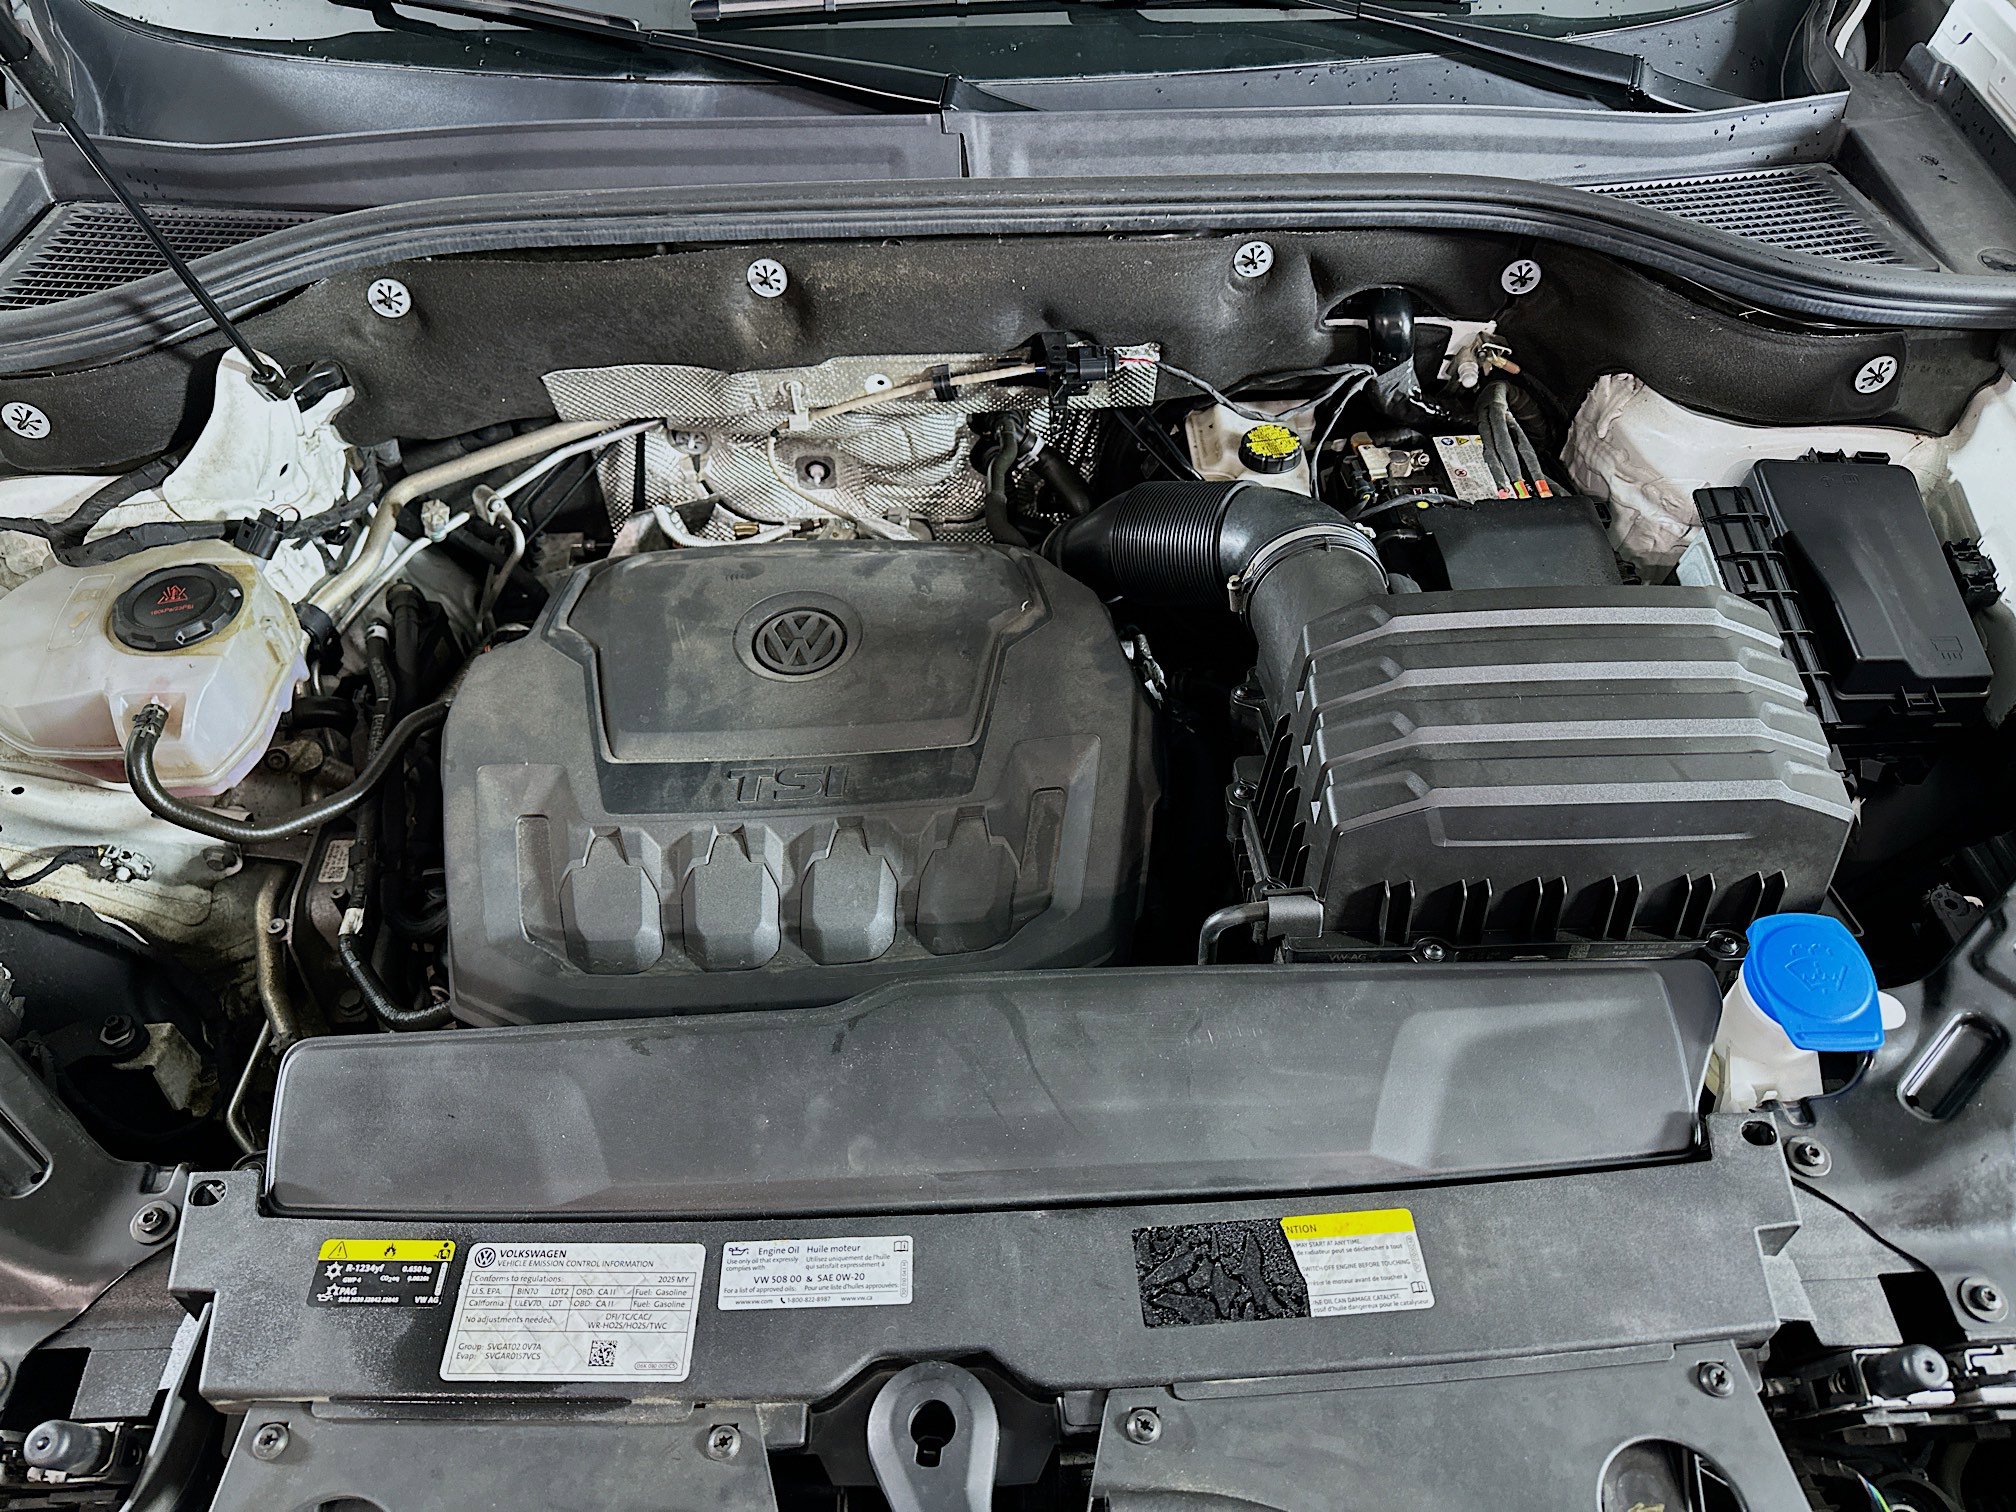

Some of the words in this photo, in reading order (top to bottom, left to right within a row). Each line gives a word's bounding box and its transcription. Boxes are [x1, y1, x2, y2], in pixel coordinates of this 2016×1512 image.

[727, 764, 849, 804] TSI
[1285, 1224, 1317, 1234] NTION
[758, 1247, 786, 1257] Engine
[787, 1246, 800, 1254] Oil
[807, 1245, 829, 1253] Huile
[830, 1244, 861, 1253] moteur
[500, 1249, 567, 1259] VOLKSWAGEN
[602, 1260, 654, 1268] INFORMATION
[738, 1258, 751, 1266] only
[772, 1256, 799, 1264] expressly
[1336, 1262, 1357, 1270] ENGINE
[1380, 1259, 1411, 1267] TOUCHING
[345, 1263, 386, 1275] R-1234yf
[401, 1265, 422, 1273] 0.650
[422, 1264, 433, 1275] kg
[753, 1275, 770, 1284] VW
[771, 1275, 788, 1283] 508
[789, 1275, 802, 1283] 00
[817, 1273, 834, 1282] SAE
[835, 1273, 866, 1281] 0W-20
[338, 1286, 358, 1296] PAG
[550, 1288, 569, 1296] LDT2
[576, 1288, 594, 1296] OBD:
[597, 1288, 609, 1296] CA
[414, 1295, 428, 1304] VW
[427, 1295, 440, 1304] AG
[1347, 1295, 1371, 1303] DAMAGE
[653, 1301, 686, 1309] Gasoline
[1347, 1303, 1378, 1311] dangereux
[1399, 1298, 1428, 1307] catalyseur
[477, 1315, 523, 1325] adjustments
[458, 1343, 484, 1352] Group:
[456, 1353, 477, 1361] Evap:
